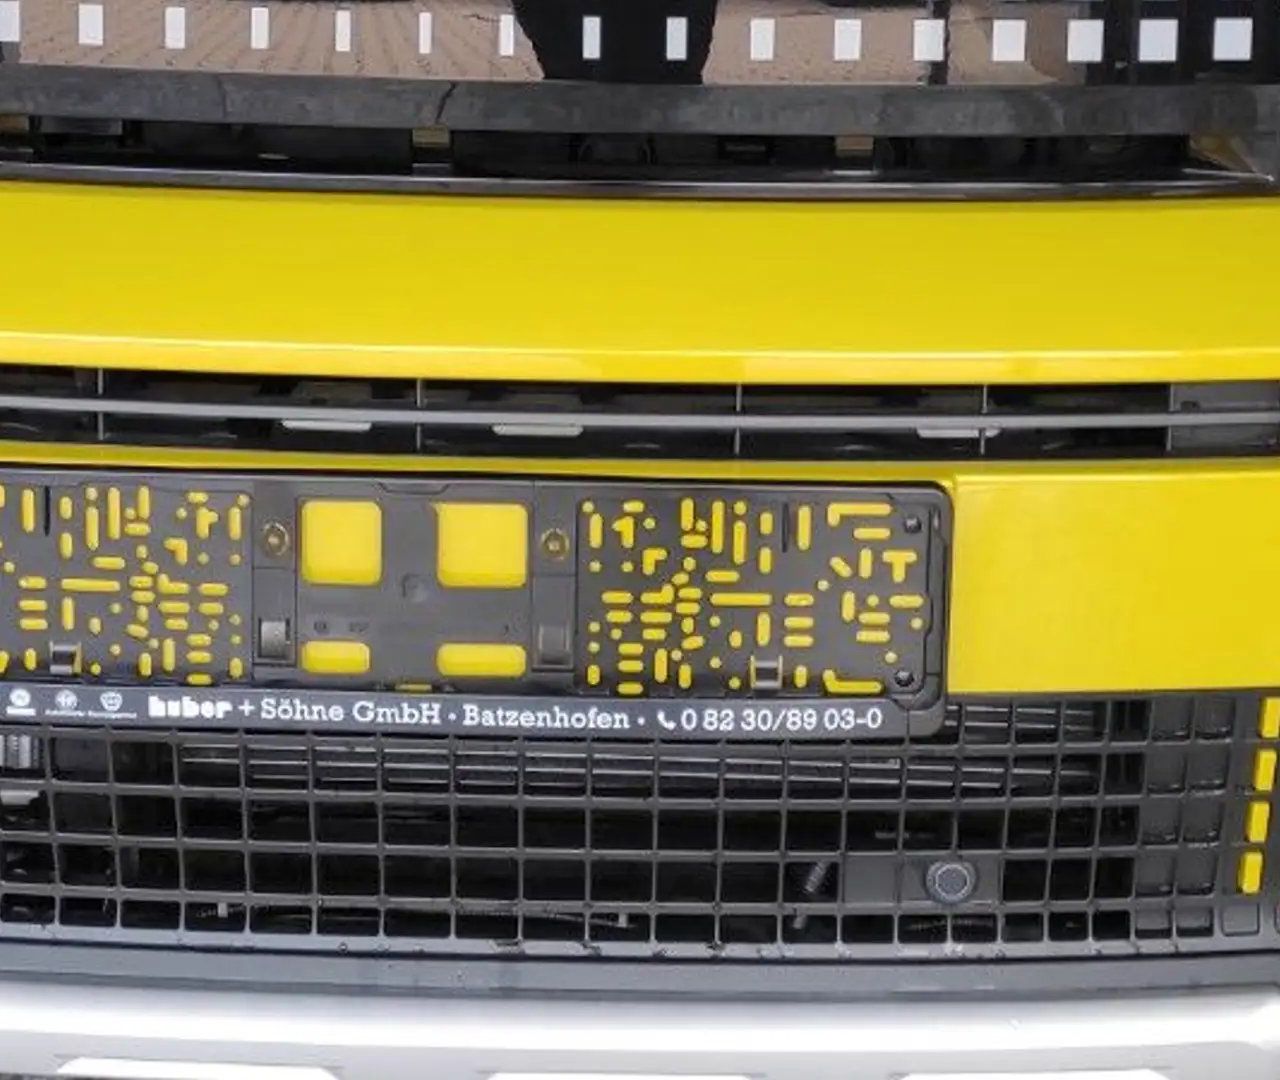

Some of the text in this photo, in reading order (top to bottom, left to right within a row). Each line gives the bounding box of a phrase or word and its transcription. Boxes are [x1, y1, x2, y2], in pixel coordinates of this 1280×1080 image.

[148, 695, 233, 718] huber
[238, 699, 256, 717] +
[261, 696, 345, 721] Söhne
[351, 700, 442, 724] GmbH
[463, 704, 630, 729] Batzenhofen
[703, 708, 735, 731] 82
[741, 708, 817, 731] 30/89
[823, 707, 882, 730] 03-0
